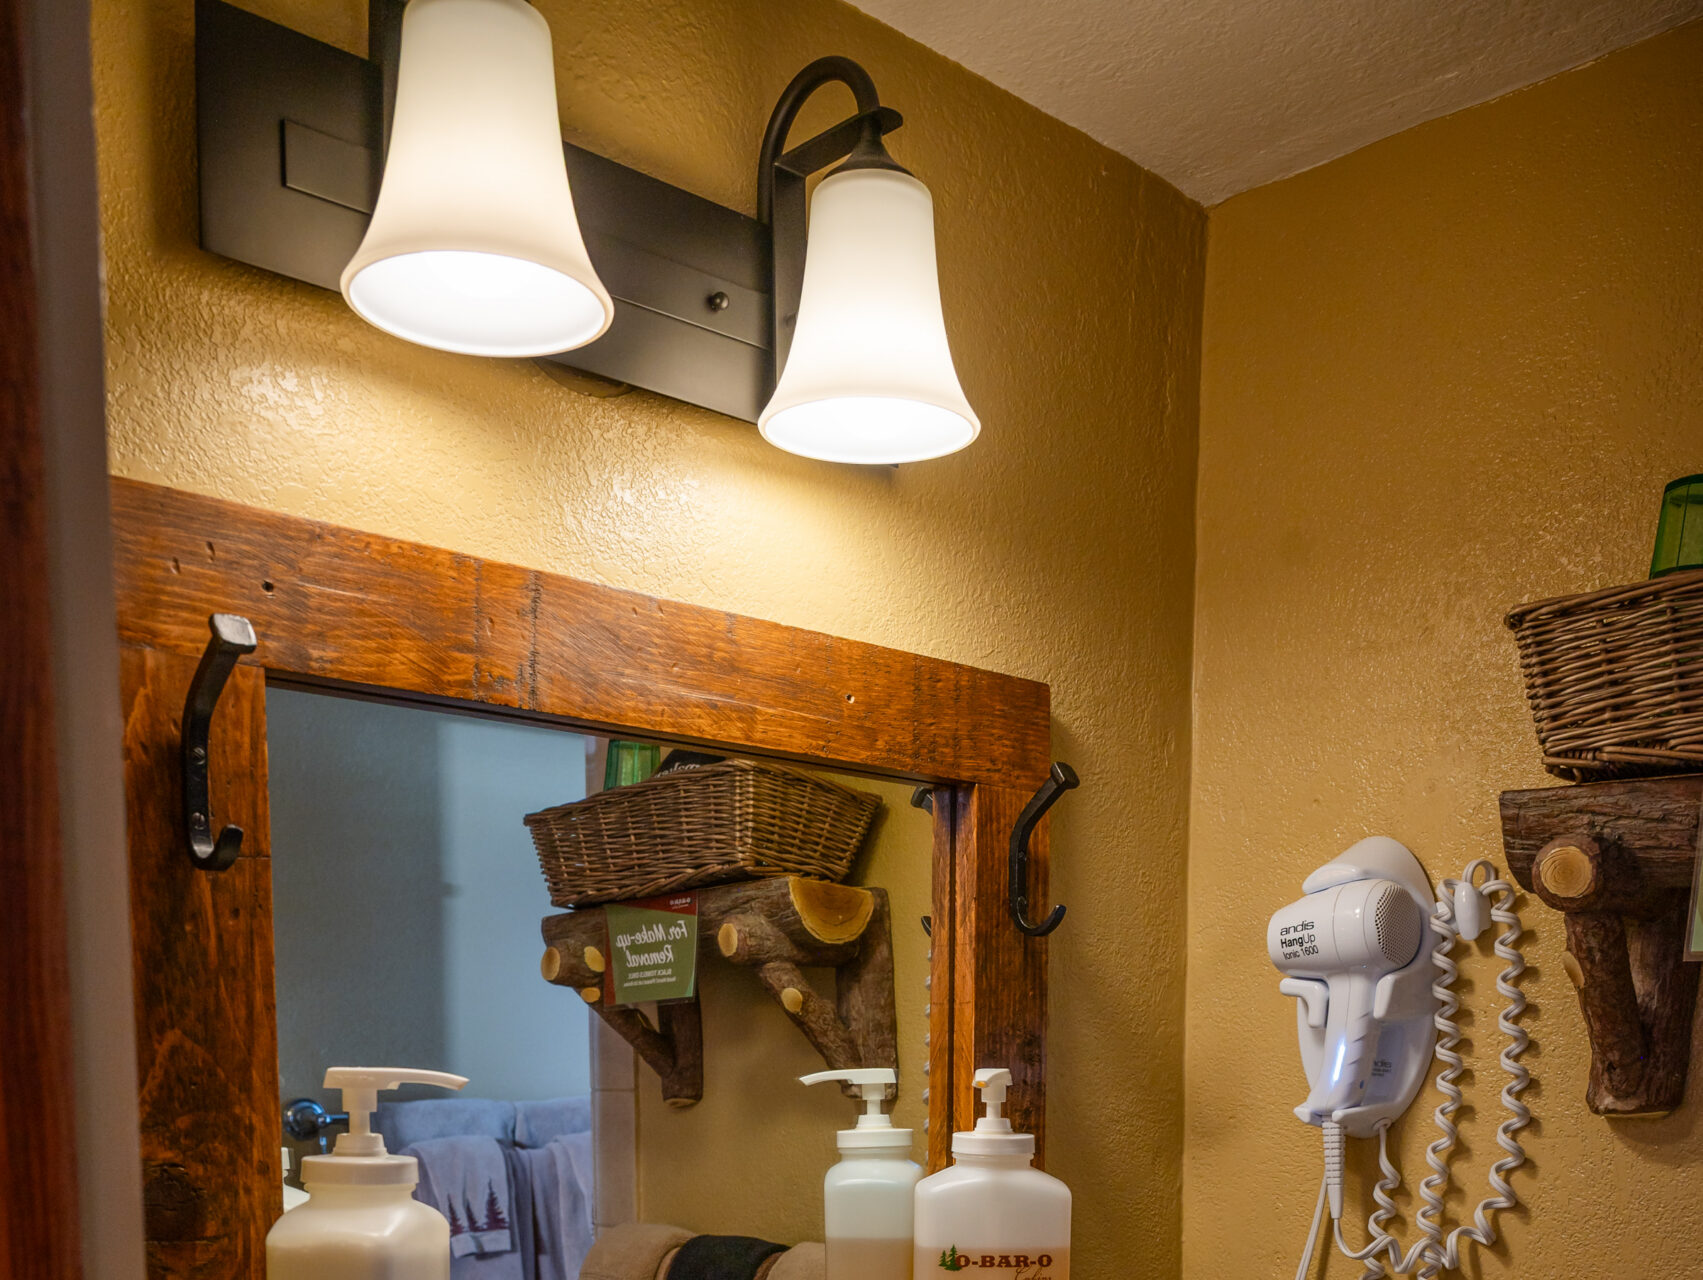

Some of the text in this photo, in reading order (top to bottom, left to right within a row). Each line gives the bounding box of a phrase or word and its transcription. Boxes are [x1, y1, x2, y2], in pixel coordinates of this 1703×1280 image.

[1280, 920, 1315, 936] andis
[1280, 932, 1316, 949] HangUp
[1282, 944, 1319, 961] Ionic 1600
[954, 1253, 1053, 1268] O-BAR-O
